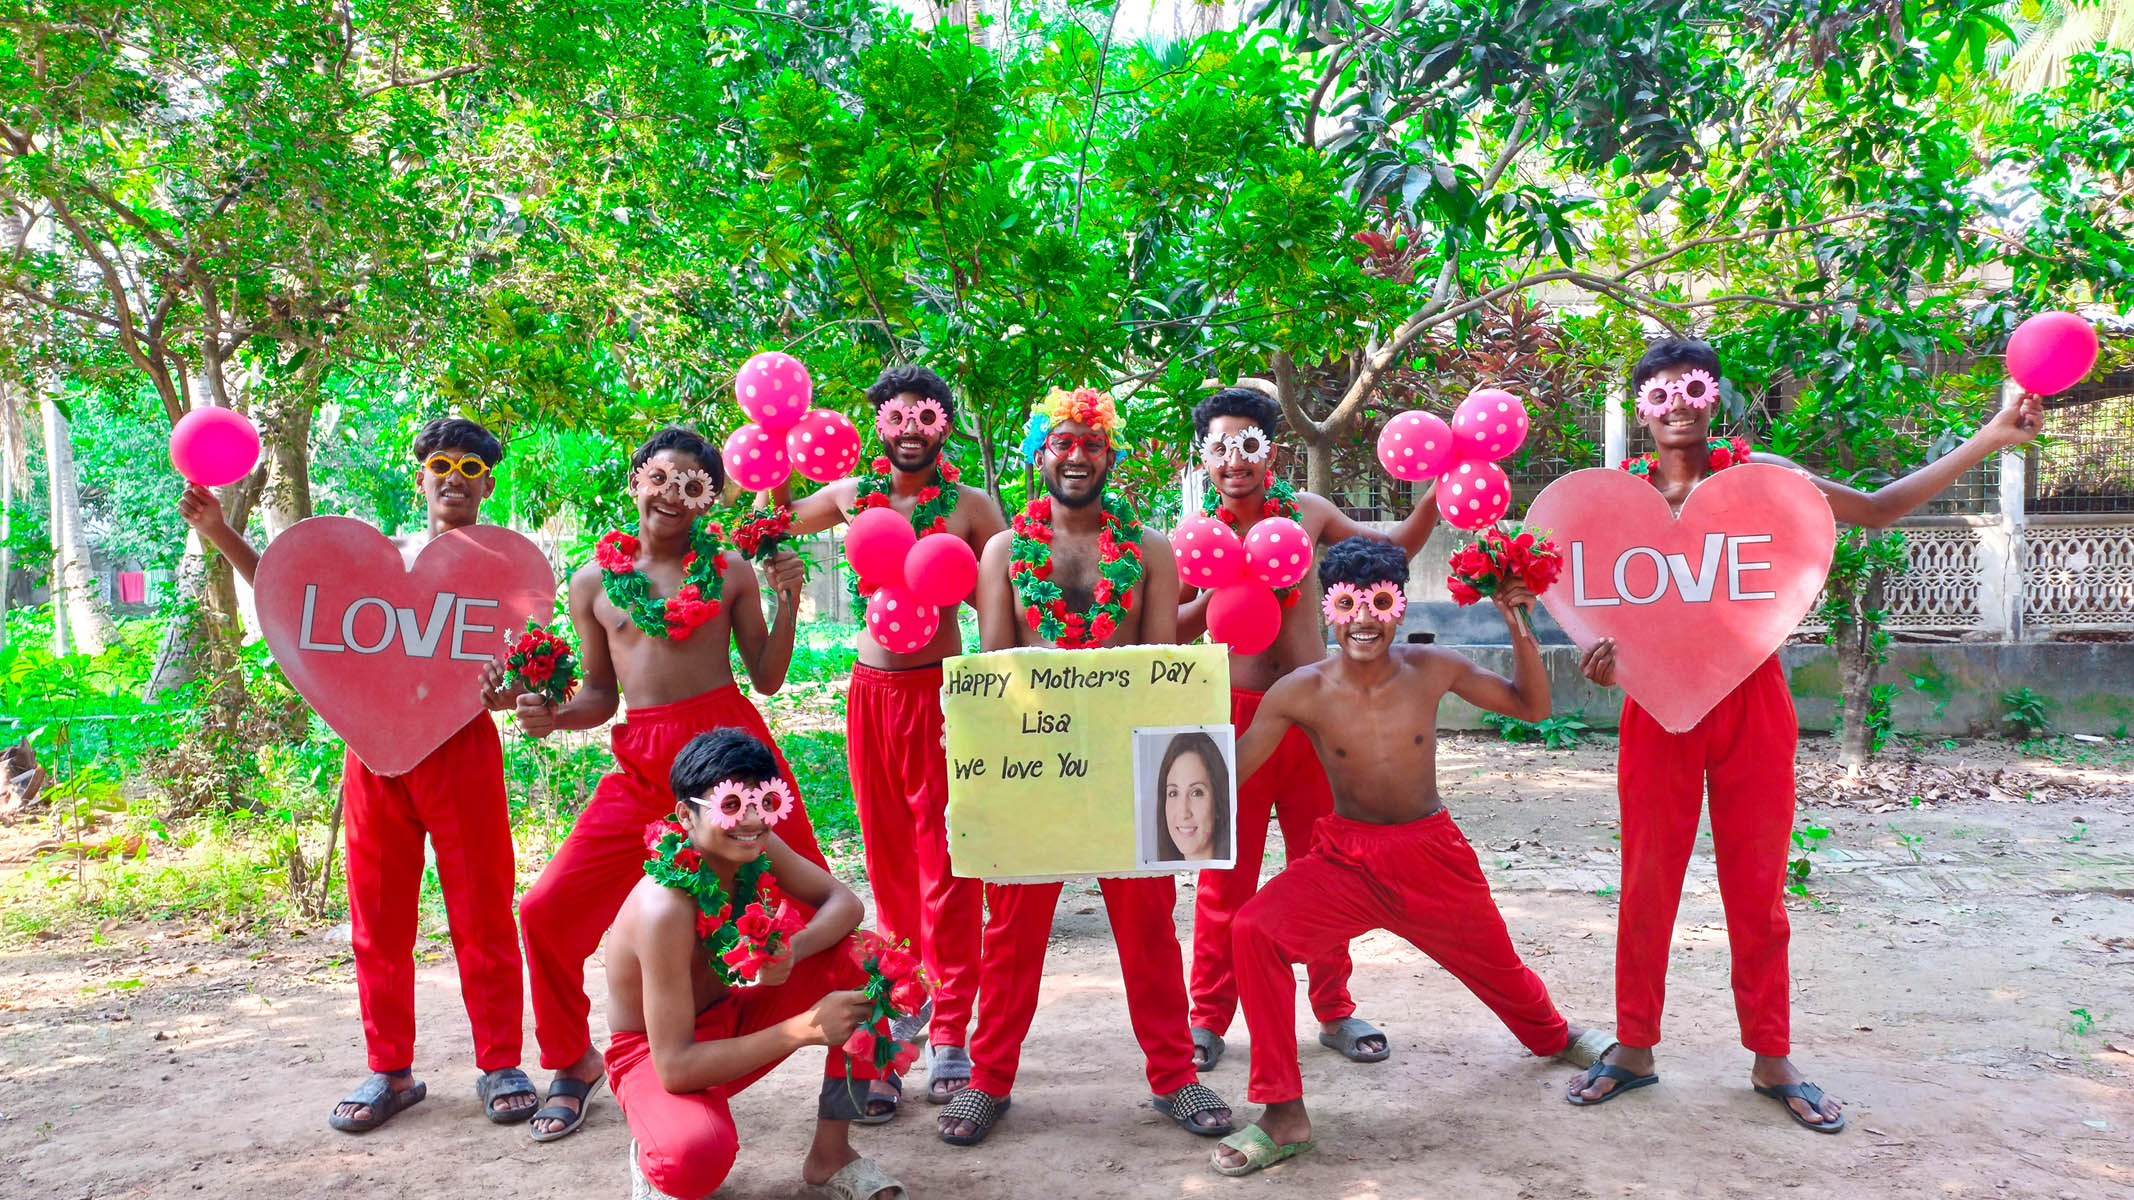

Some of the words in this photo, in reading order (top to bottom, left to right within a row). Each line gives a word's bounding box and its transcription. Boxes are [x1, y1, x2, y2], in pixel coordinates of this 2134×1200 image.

[1571, 532, 1776, 607] LOVE
[298, 583, 499, 662] LOVE
[949, 671, 1012, 698] Happy
[1030, 666, 1130, 690] Mother's
[1151, 660, 1196, 685] Day
[1022, 710, 1072, 734] Lisa
[1001, 755, 1043, 780] love
[1057, 752, 1089, 778] You
